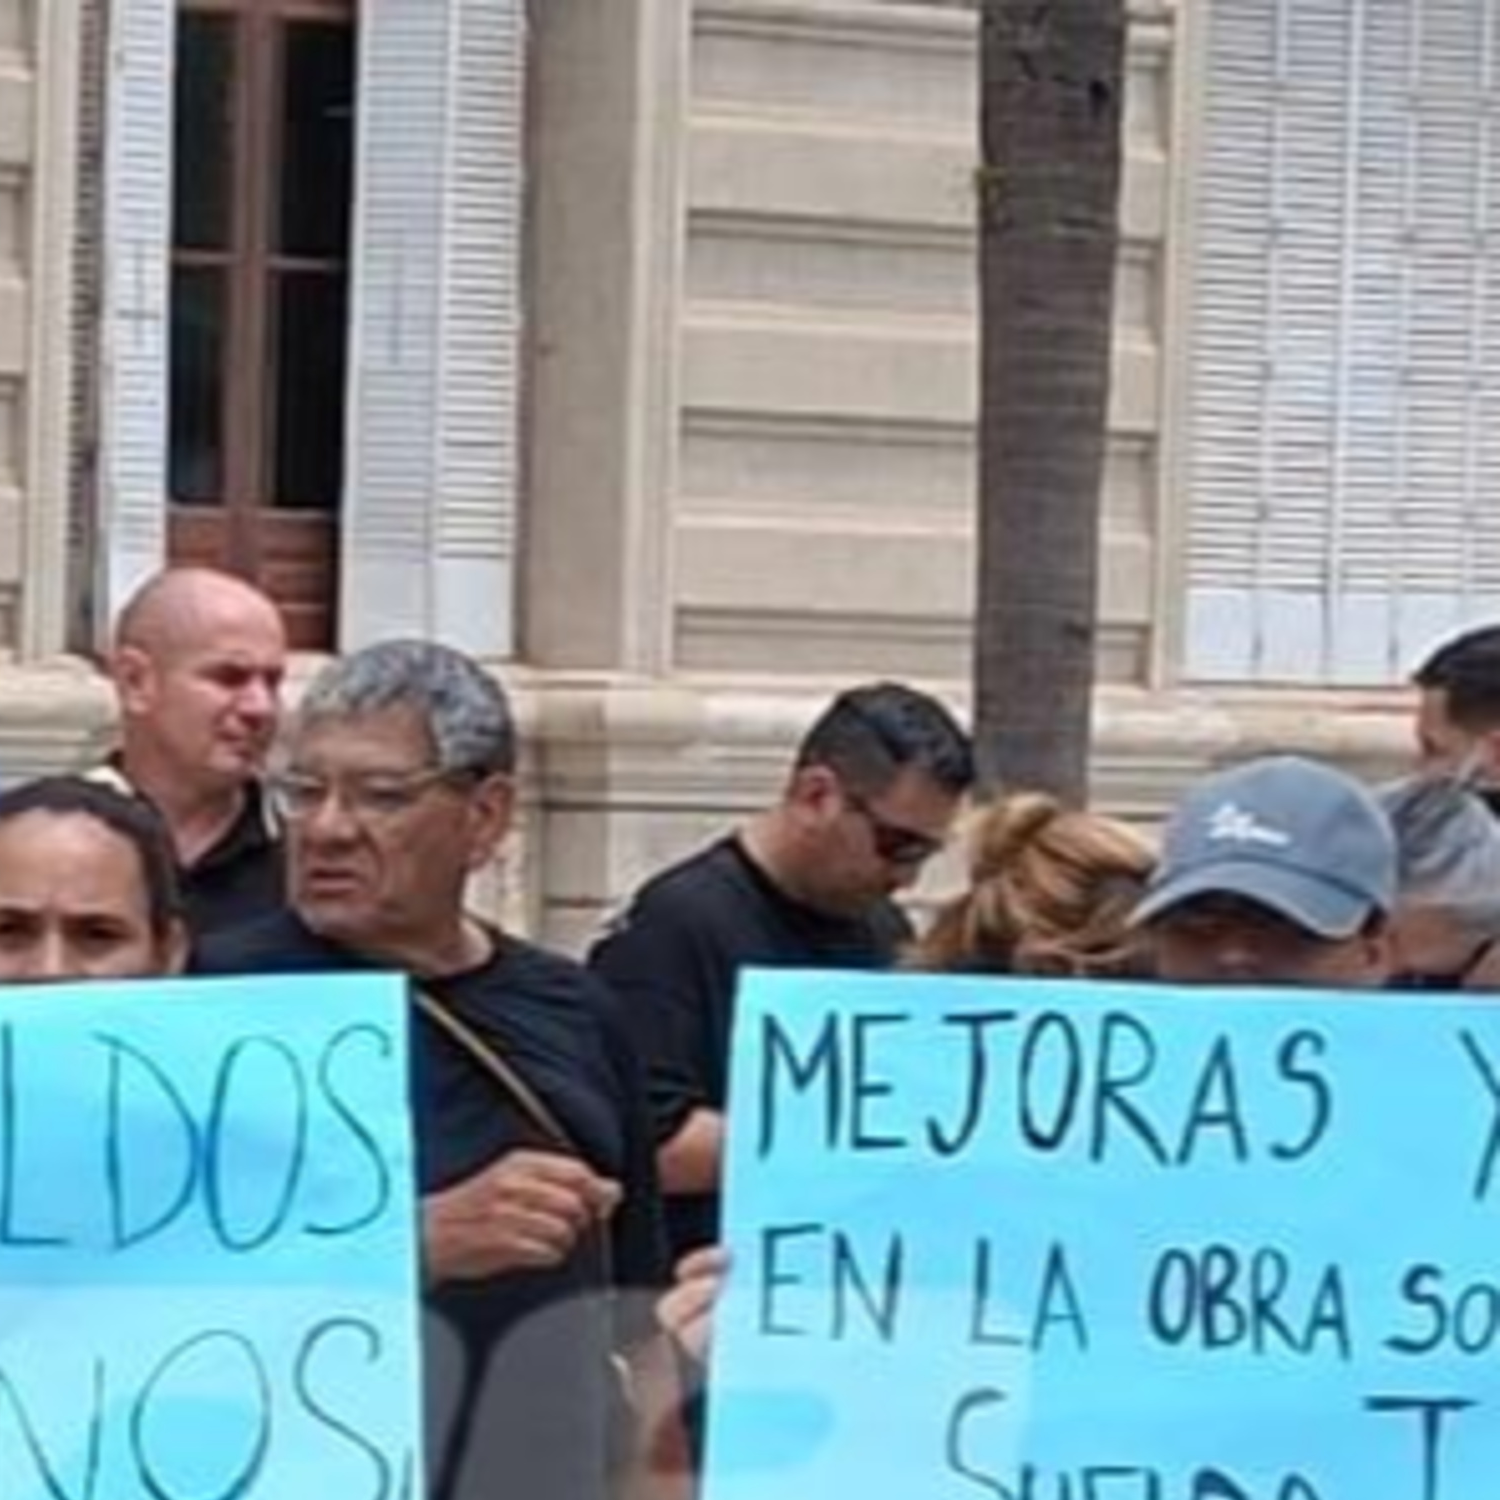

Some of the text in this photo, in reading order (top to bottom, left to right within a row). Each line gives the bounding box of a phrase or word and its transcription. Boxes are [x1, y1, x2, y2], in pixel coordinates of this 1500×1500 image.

[756, 1009, 1334, 1168] MEJORAS
[757, 1221, 903, 1344] EN
[969, 1236, 1090, 1353] LA
[1147, 1243, 1352, 1360] OBRA
